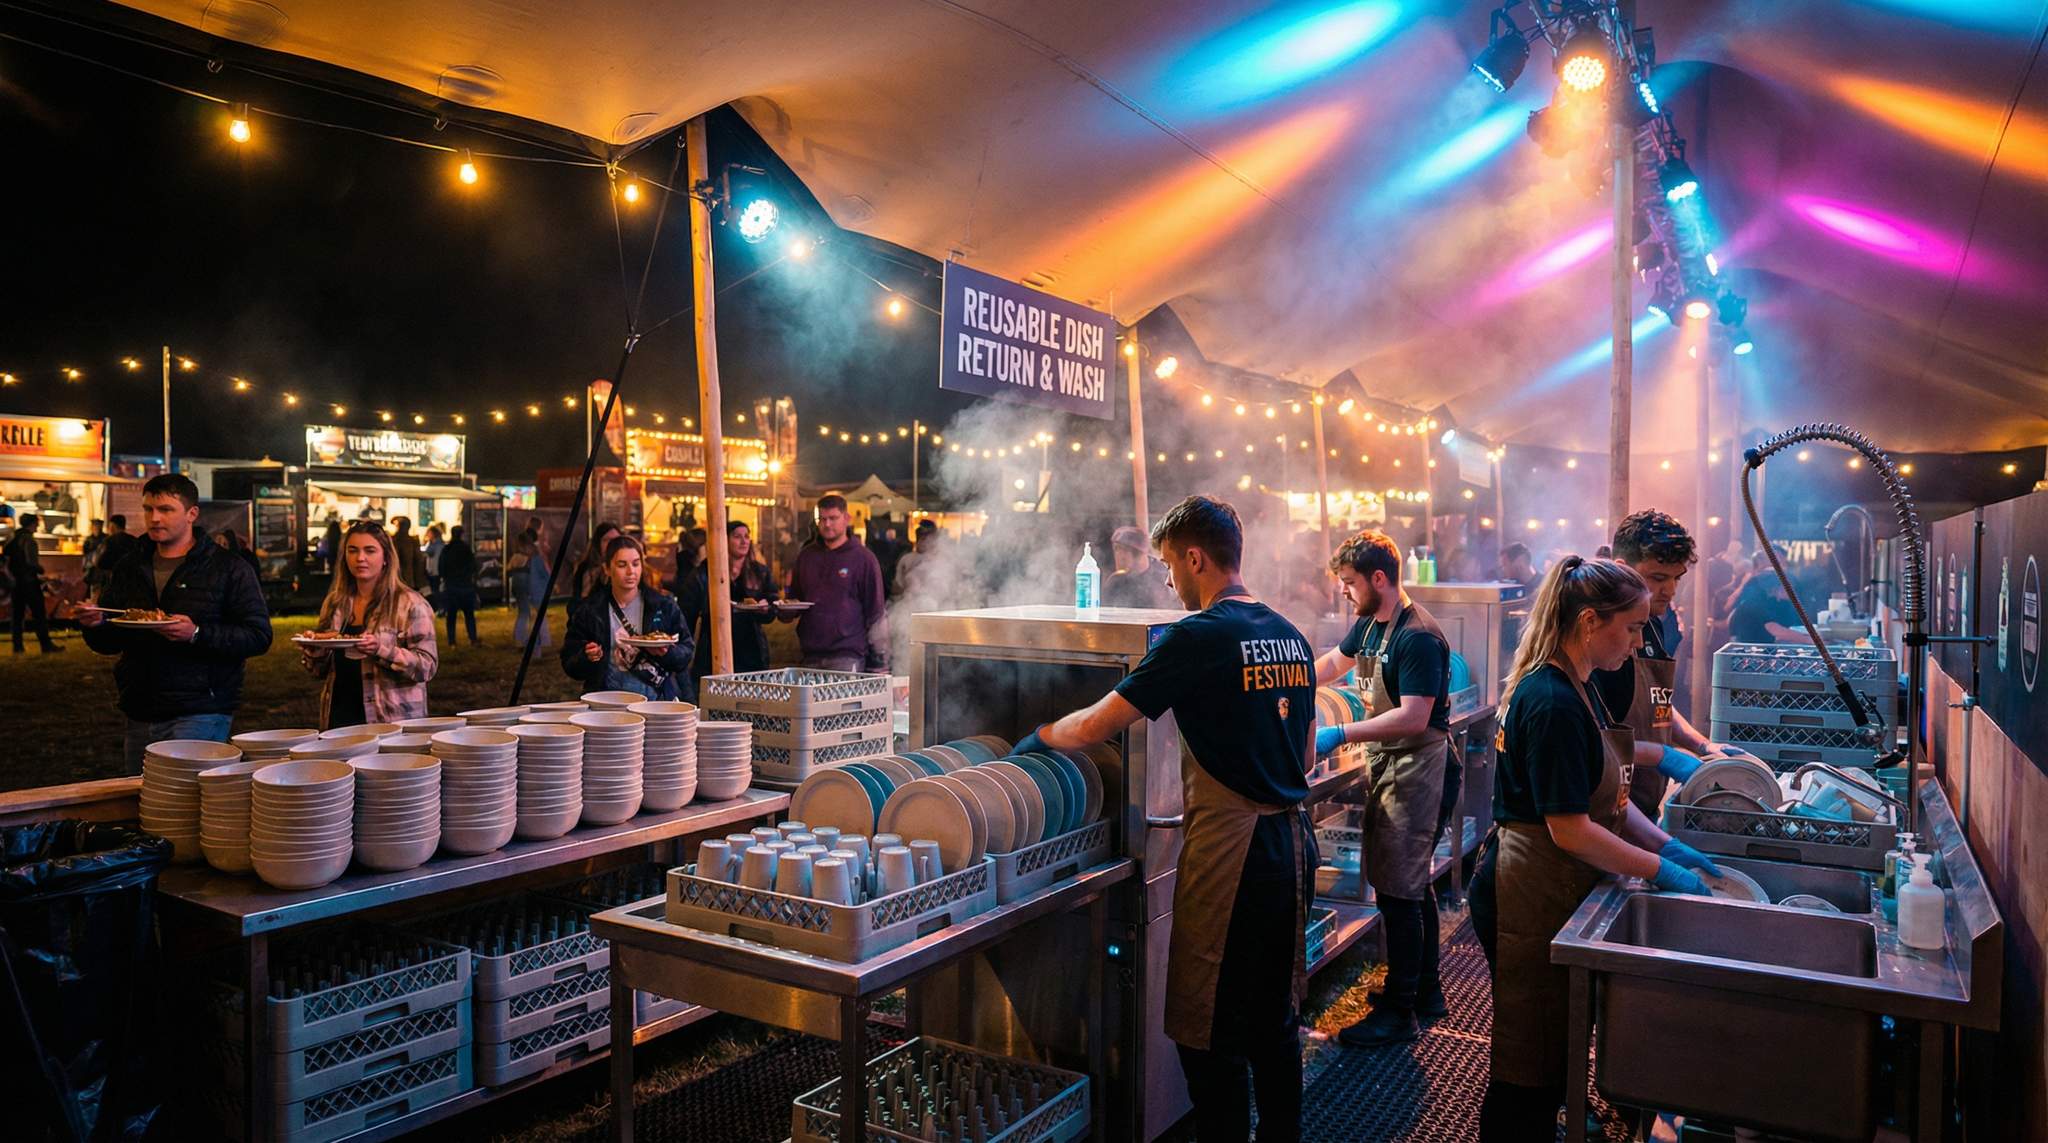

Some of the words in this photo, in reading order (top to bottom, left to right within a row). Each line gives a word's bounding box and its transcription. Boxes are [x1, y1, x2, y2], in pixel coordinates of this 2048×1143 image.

[963, 286, 1061, 350] REUSABLE
[1065, 317, 1104, 361] DISH
[957, 332, 1035, 388] RETURN
[1039, 354, 1053, 391] &
[1057, 358, 1105, 402] WASH
[1240, 639, 1308, 665] FESTIVAL
[1243, 664, 1310, 691] FESTIVAL
